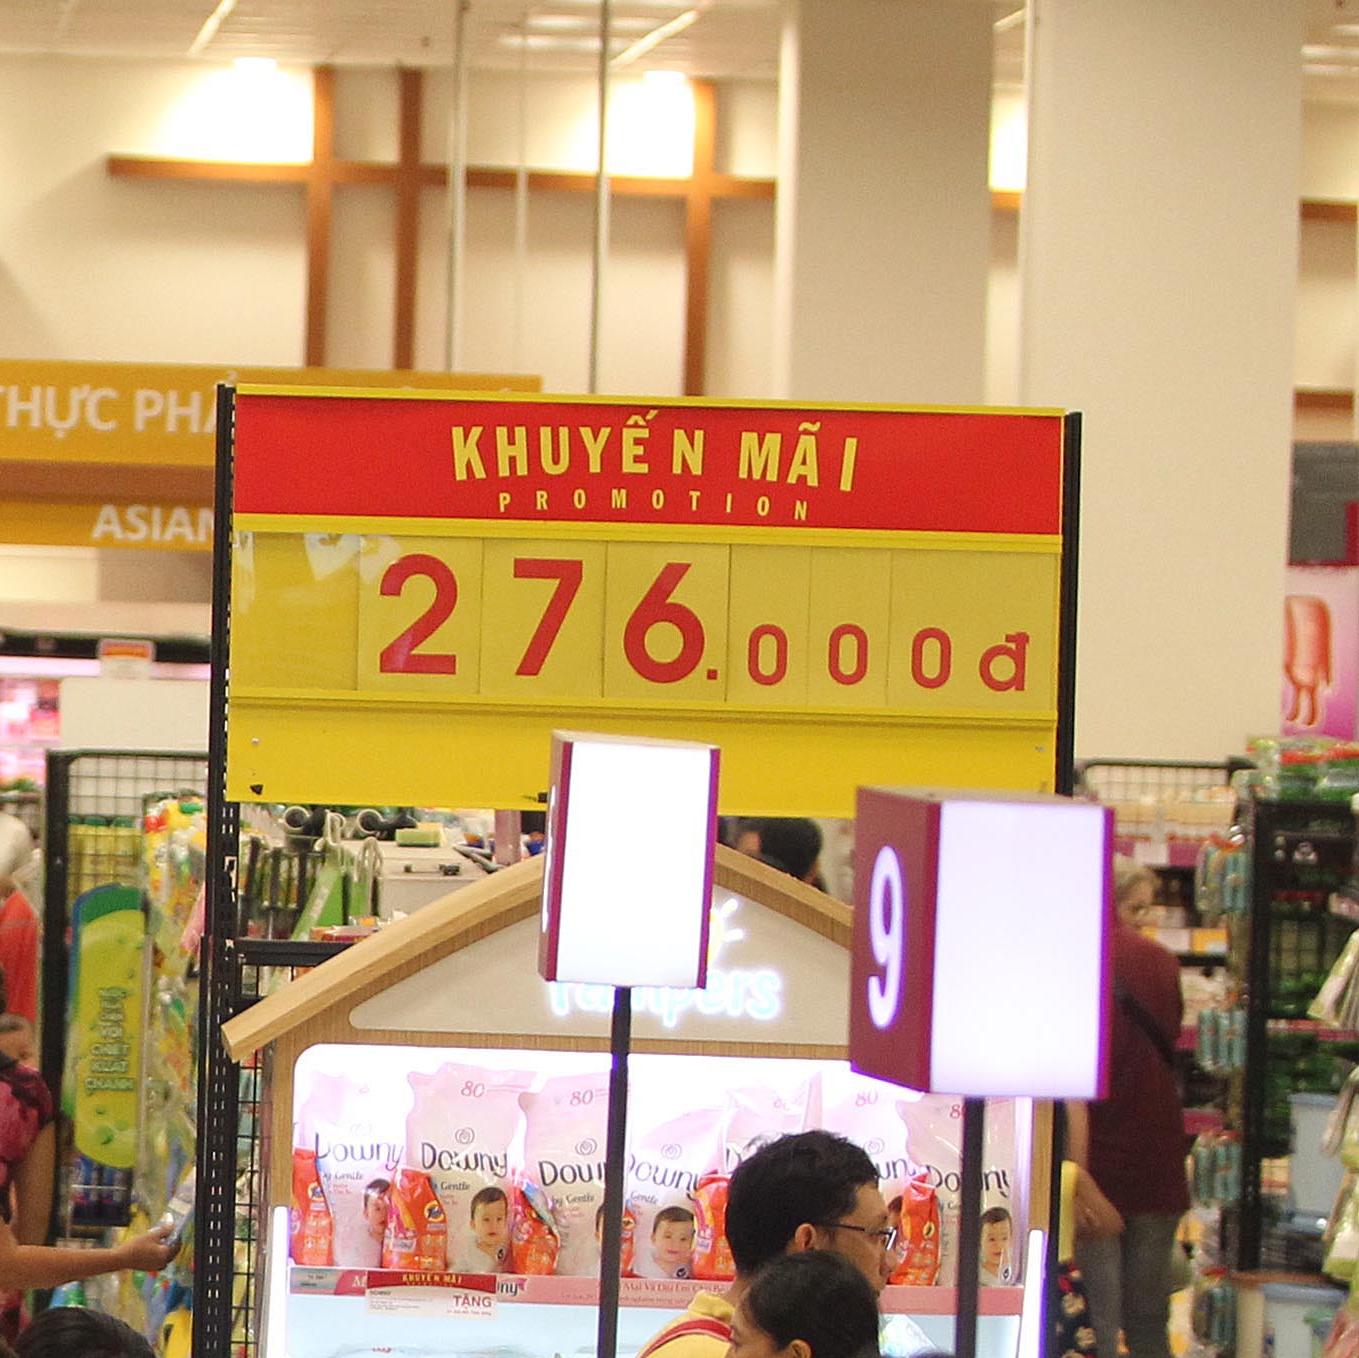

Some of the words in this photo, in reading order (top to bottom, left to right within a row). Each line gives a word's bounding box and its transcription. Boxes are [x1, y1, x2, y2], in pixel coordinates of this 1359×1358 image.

[450, 409, 705, 481] KHUYẾN
[737, 421, 858, 492] MÃI
[498, 488, 808, 521] PROMOTION
[378, 552, 1031, 693] 276.000đ
[866, 844, 908, 1031] 9
[461, 1080, 485, 1098] 80
[569, 1089, 594, 1106] 80
[949, 1103, 965, 1119] 8
[420, 1141, 508, 1178] Downy
[926, 1165, 1011, 1199] Dony
[452, 1293, 492, 1310] TẶNG
